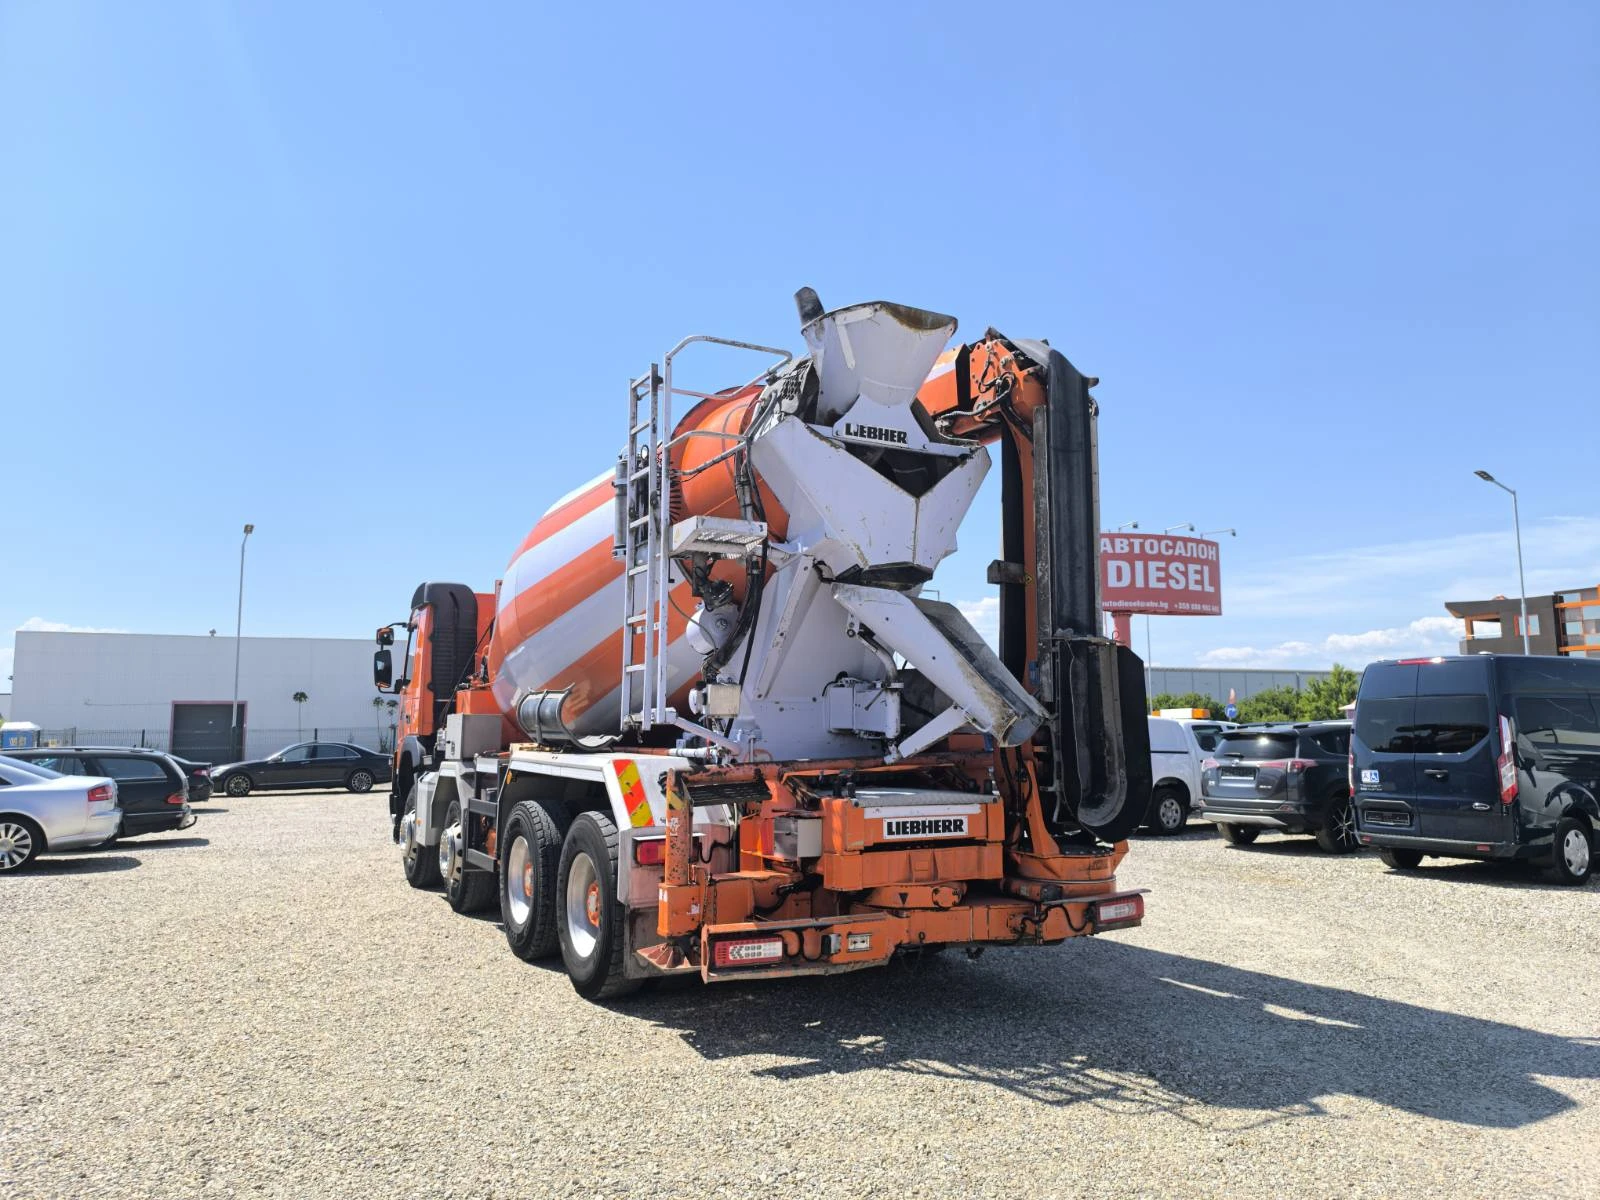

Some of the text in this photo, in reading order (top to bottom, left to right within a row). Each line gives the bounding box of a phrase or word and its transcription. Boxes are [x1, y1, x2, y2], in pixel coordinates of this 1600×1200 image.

[1100, 538, 1217, 560] АВТОСАЛОН
[1107, 560, 1215, 592] DIESEL
[886, 819, 965, 835] LIEBHERR
